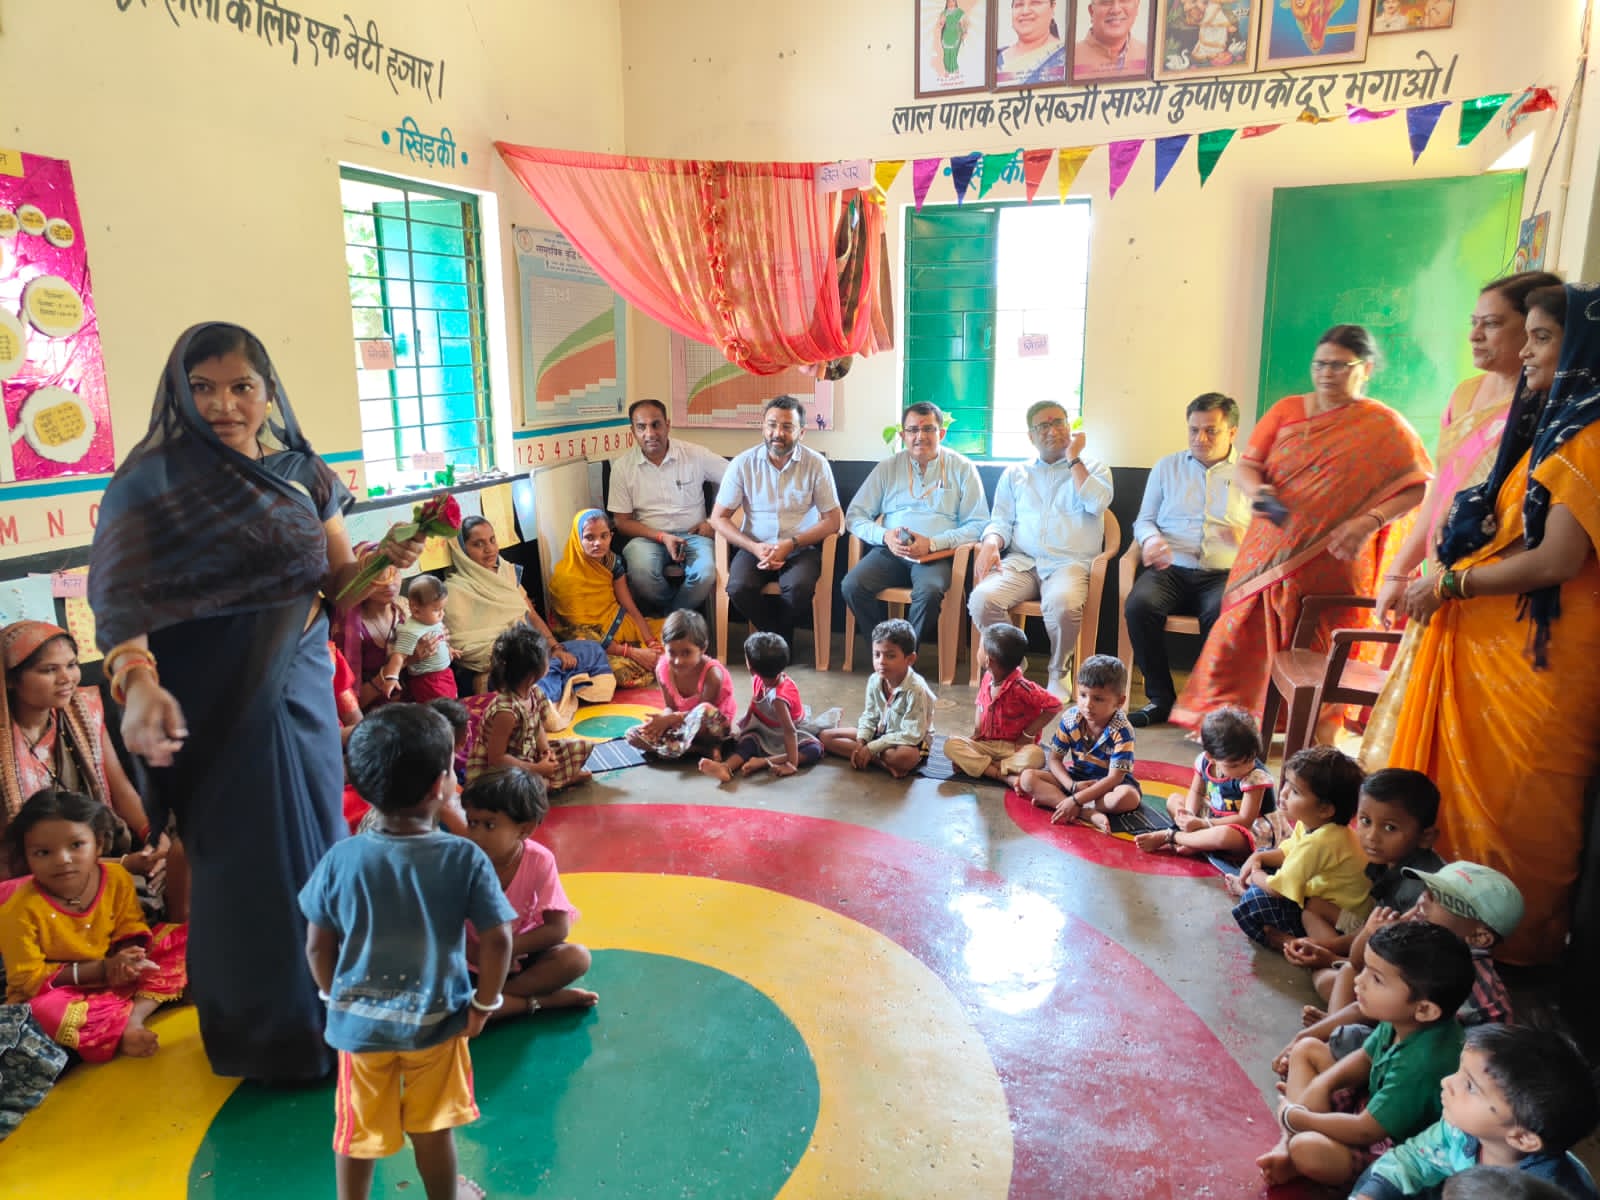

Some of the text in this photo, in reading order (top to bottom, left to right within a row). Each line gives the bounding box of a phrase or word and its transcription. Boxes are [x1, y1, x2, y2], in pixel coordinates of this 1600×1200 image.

[304, 16, 341, 67] एक
[344, 13, 385, 75] बेटी
[891, 103, 937, 135] लाल
[939, 99, 996, 131] पालक
[997, 88, 1034, 137] हरी
[1034, 83, 1102, 127] सब्जी
[1167, 76, 1266, 125] कुपोषण
[1264, 69, 1300, 110] को
[1295, 73, 1339, 118] दूर
[394, 115, 457, 170] खिड़की
[517, 431, 634, 465] 1 2 3 4 5 6 7 8 9 10
[347, 468, 360, 491] Z
[0, 515, 19, 547] M
[47, 510, 66, 538] N
